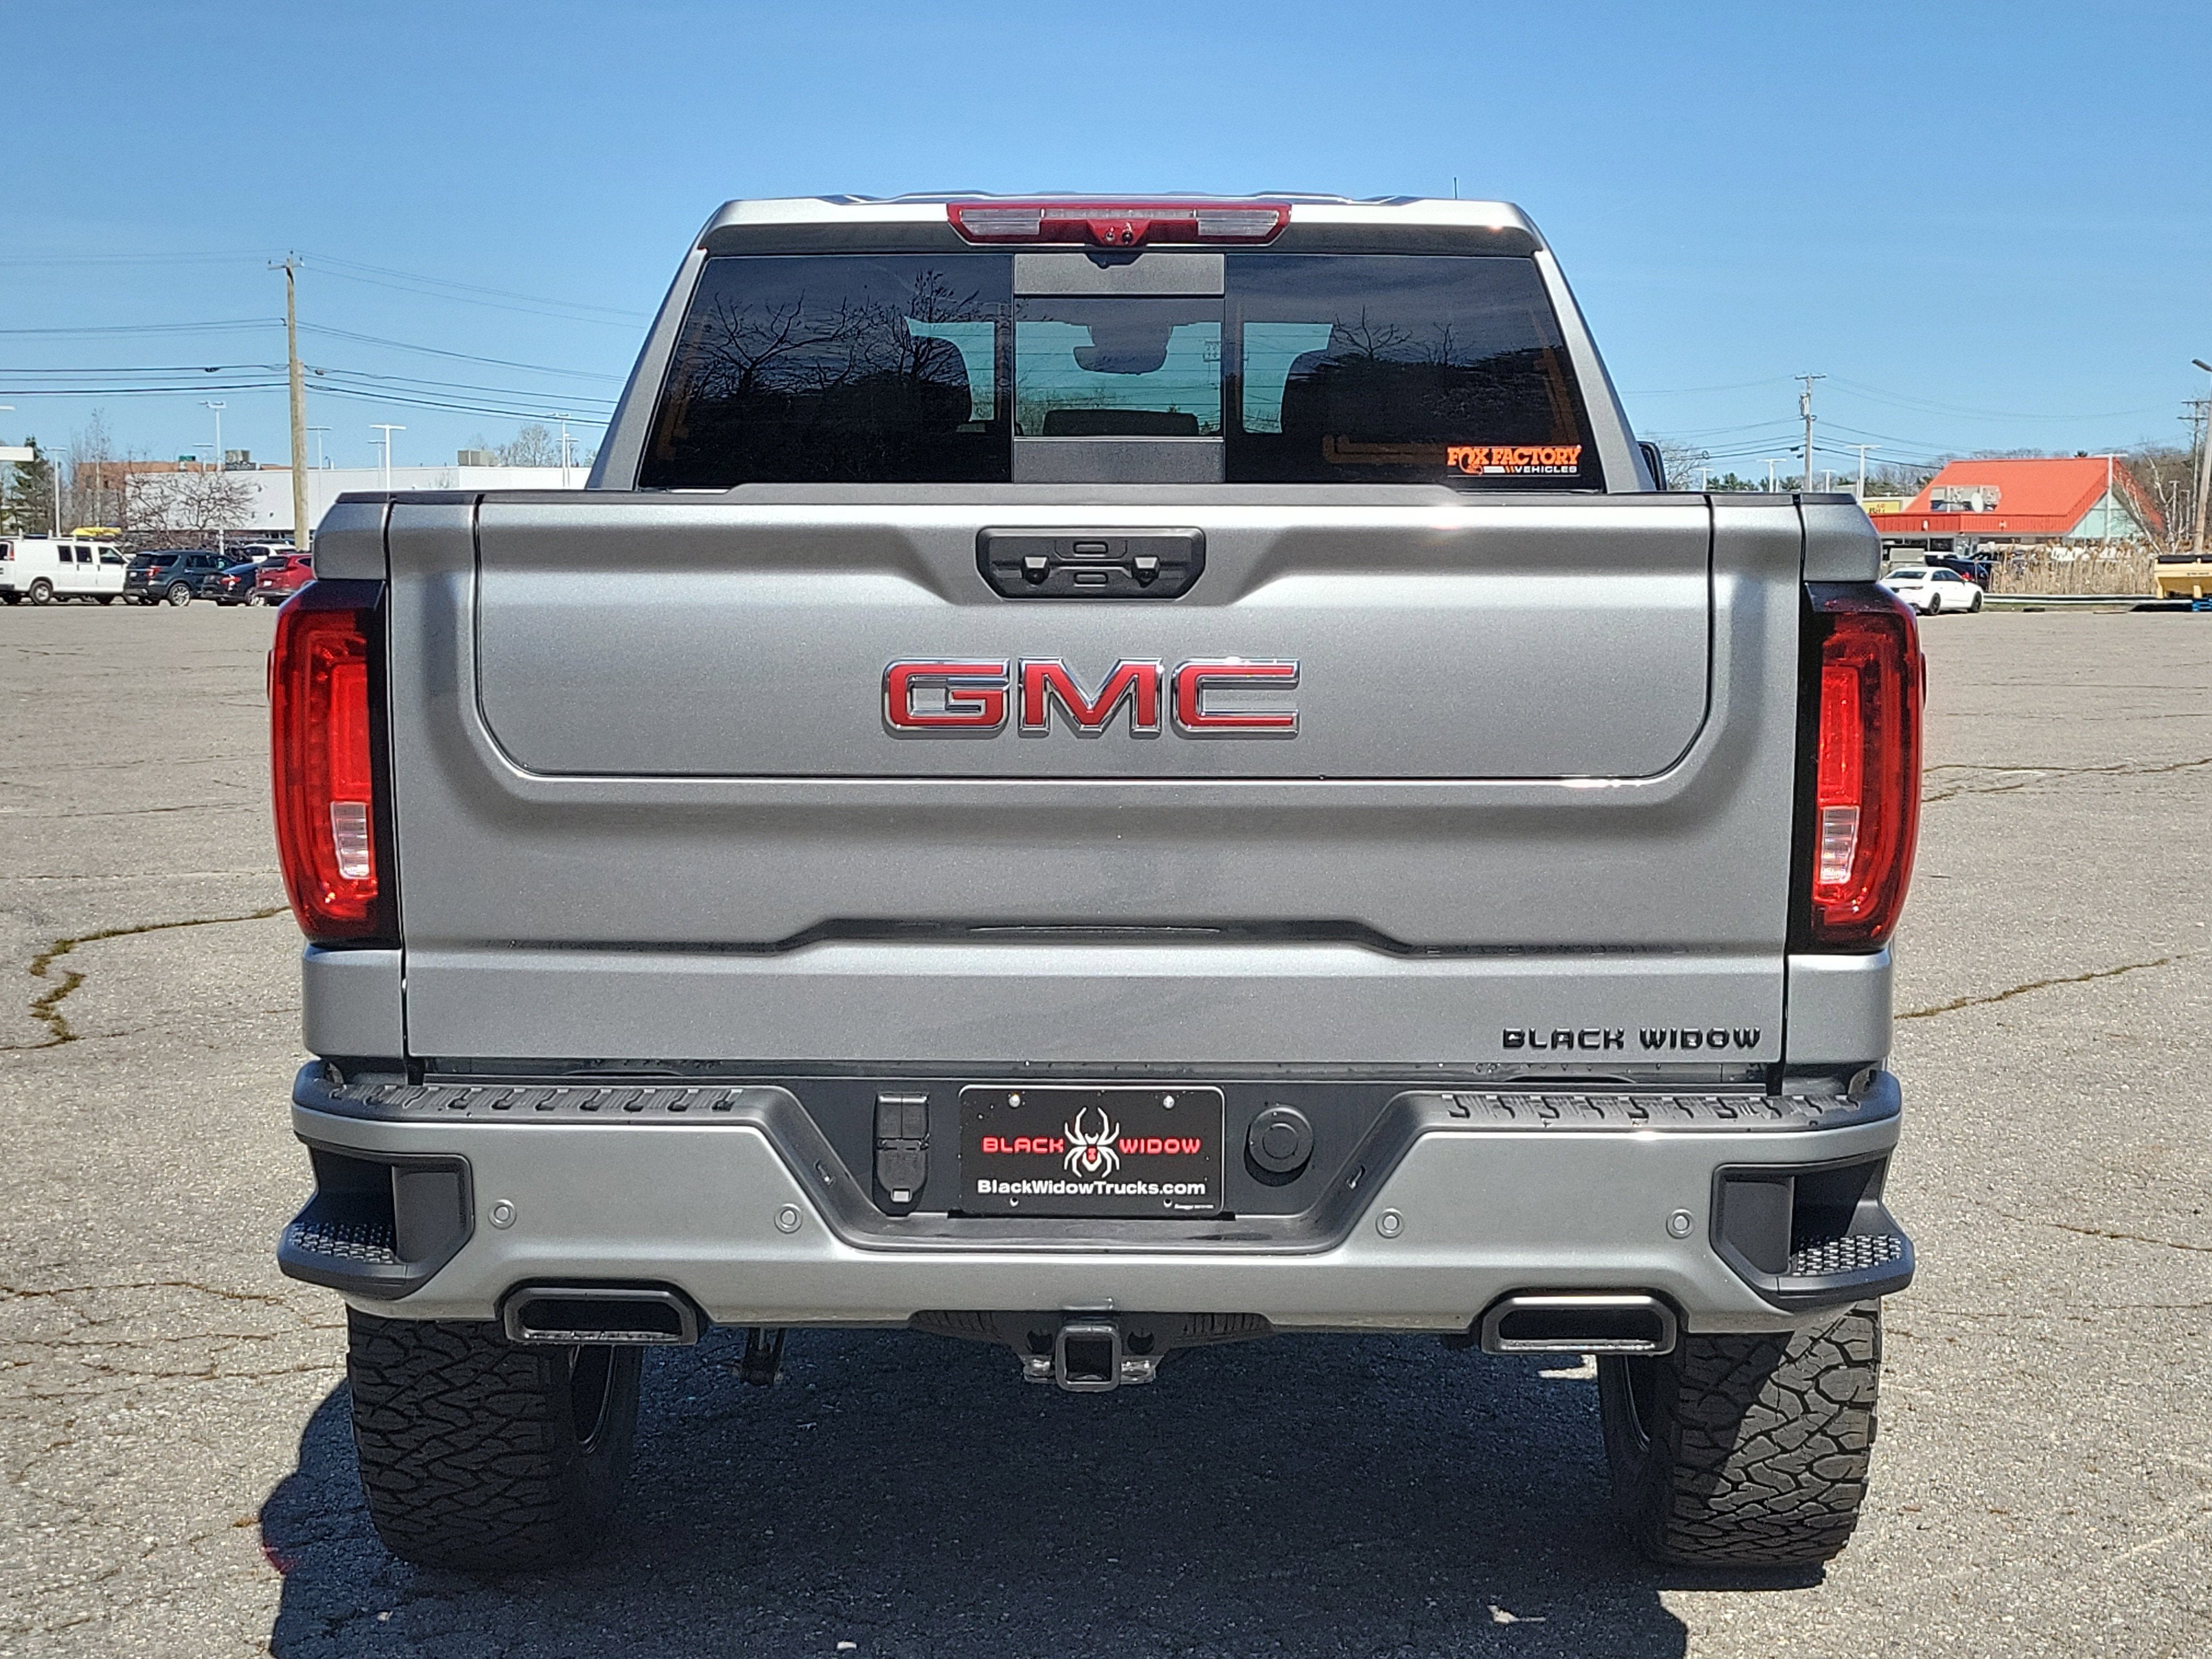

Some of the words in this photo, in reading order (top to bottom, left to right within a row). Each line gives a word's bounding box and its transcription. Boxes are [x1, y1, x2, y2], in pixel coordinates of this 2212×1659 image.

[1447, 447, 1489, 473] FOX
[1491, 445, 1581, 465] FACTORY
[882, 657, 1300, 738] GMC
[1503, 1028, 1624, 1049] BLACK
[1639, 1028, 1761, 1049] WIDOW
[981, 1136, 1064, 1154] BLACK
[1119, 1137, 1201, 1154] WIDOW
[977, 1179, 1206, 1195] BlackWidowTrucks.com
